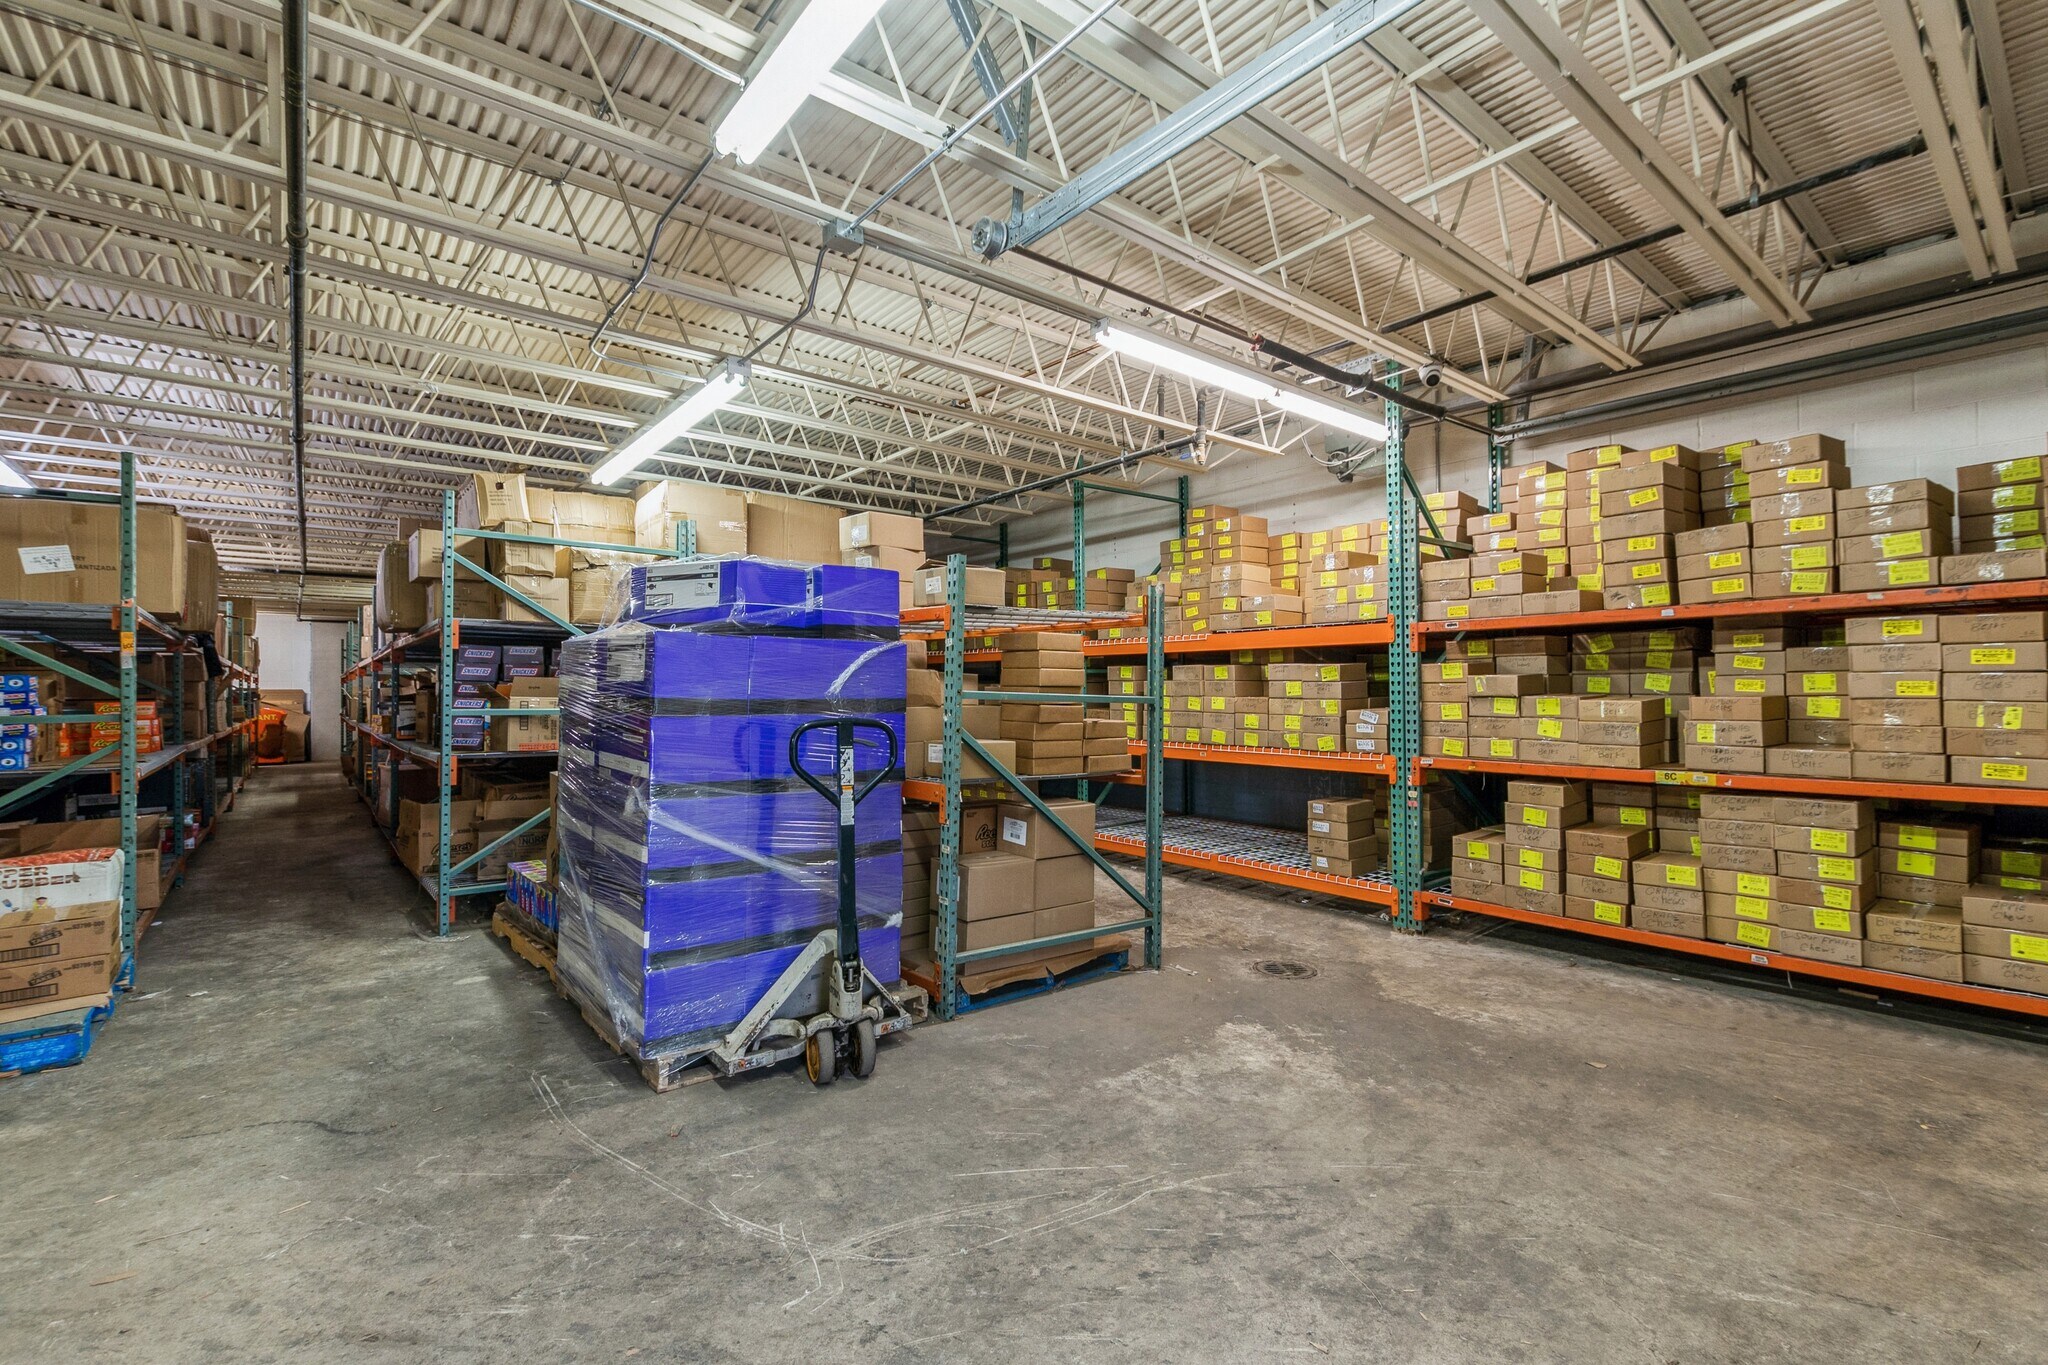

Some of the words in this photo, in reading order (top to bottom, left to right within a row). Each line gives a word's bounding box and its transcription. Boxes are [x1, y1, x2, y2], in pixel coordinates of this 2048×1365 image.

[1664, 772, 1677, 782] 6C
[0, 866, 49, 879] PER
[0, 873, 80, 890] UBBER
